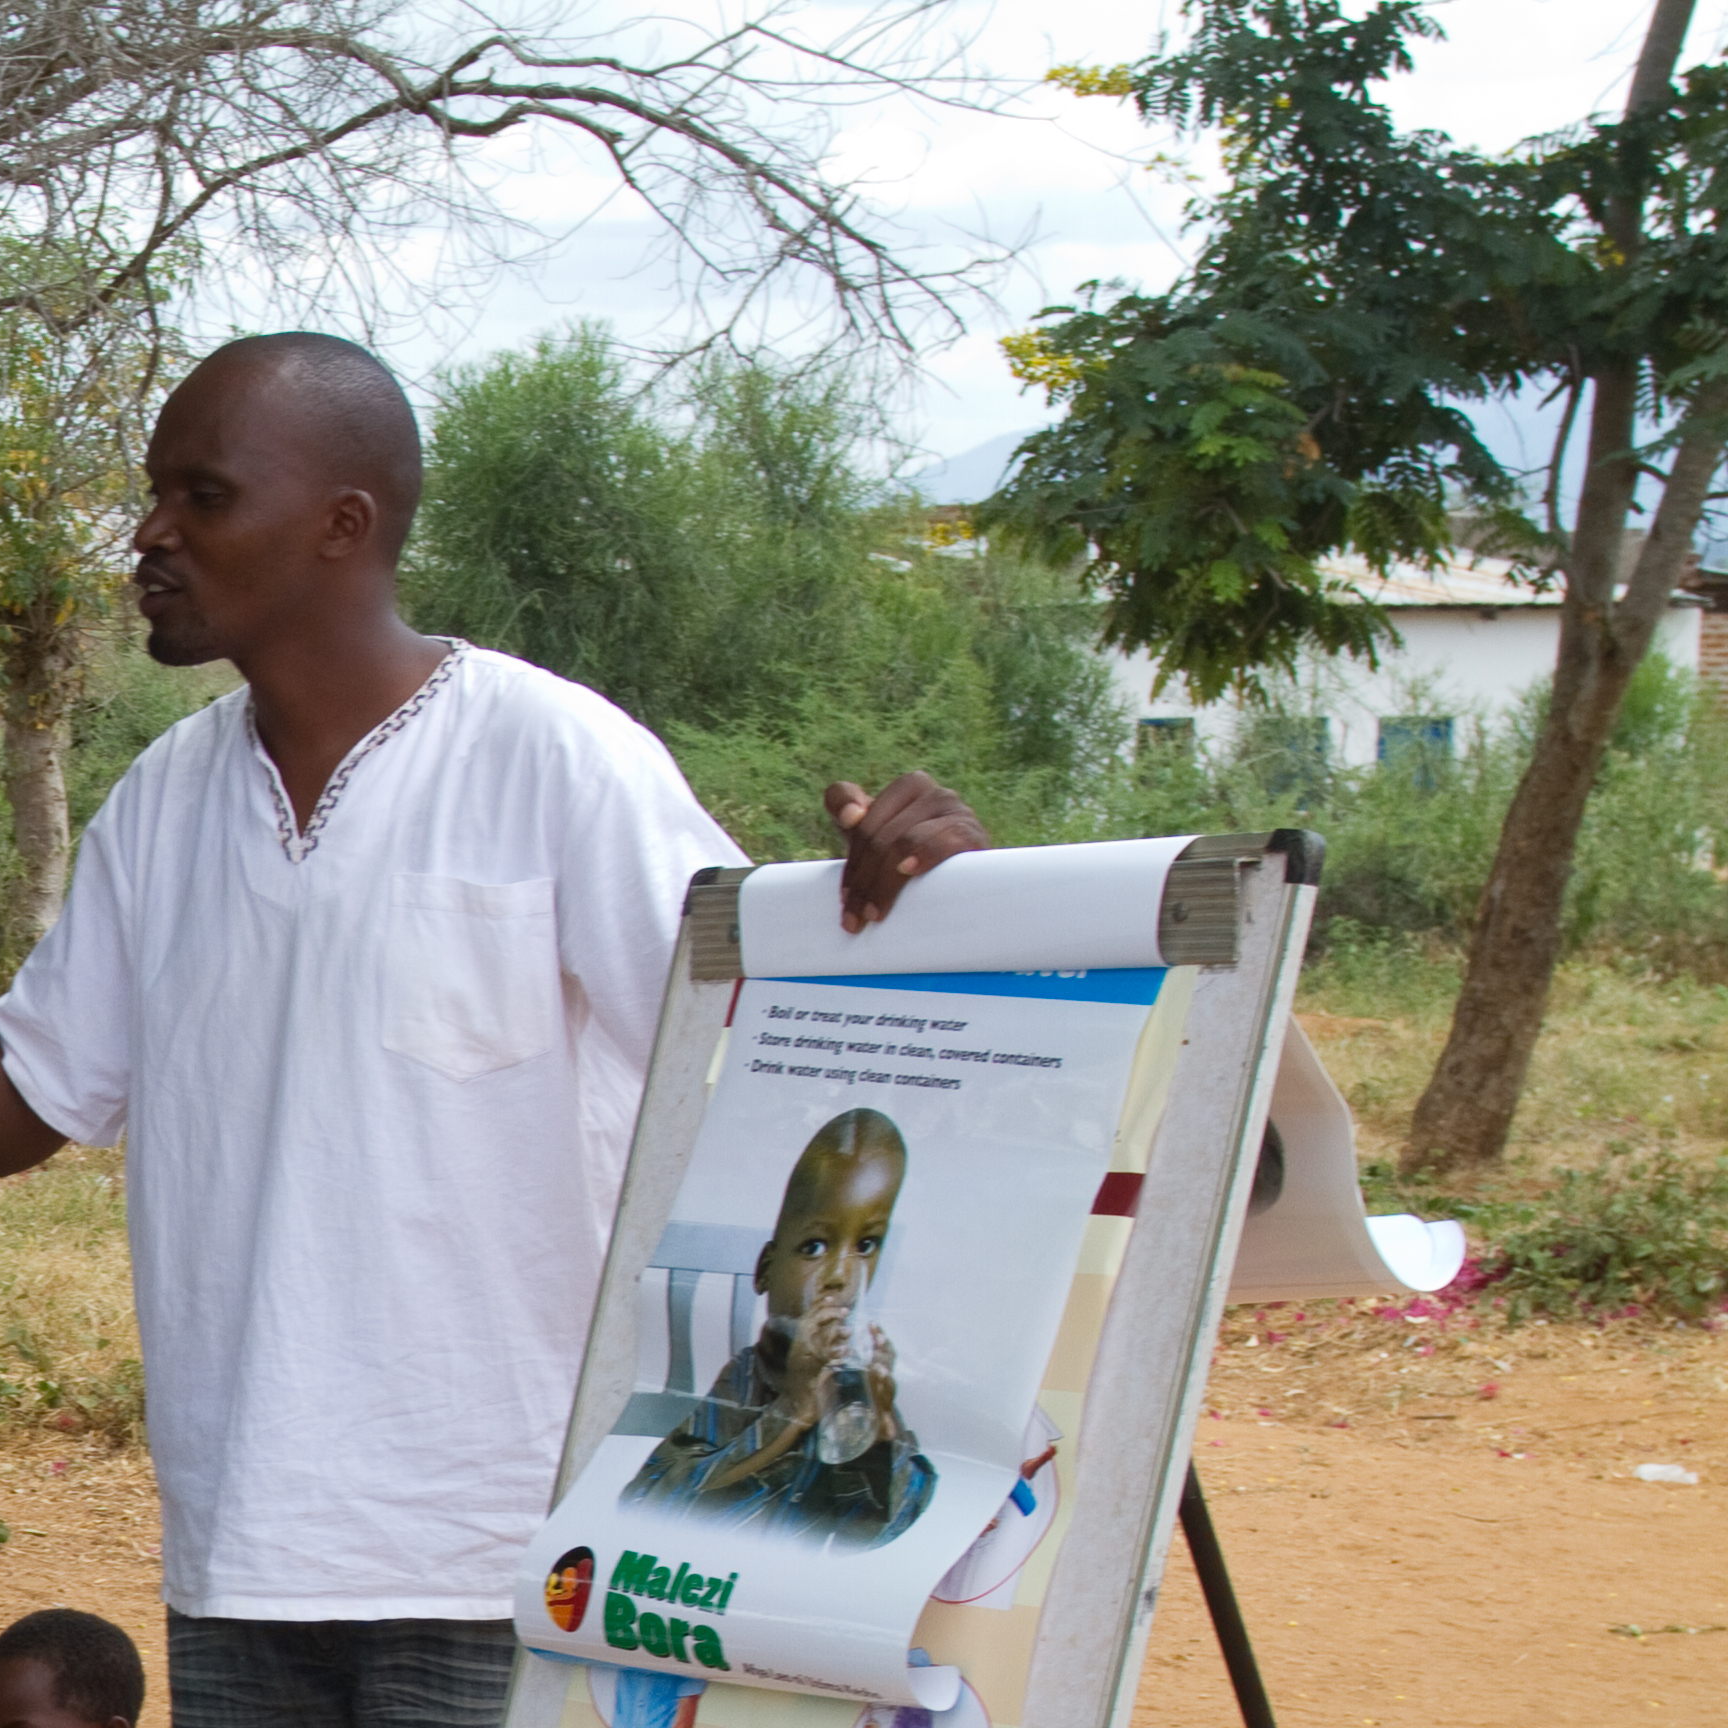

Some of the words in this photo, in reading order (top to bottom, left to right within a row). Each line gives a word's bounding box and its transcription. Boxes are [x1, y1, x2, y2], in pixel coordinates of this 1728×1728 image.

[767, 1005, 794, 1019] Boil
[794, 1010, 810, 1020] or
[810, 1009, 843, 1023] treat
[842, 1014, 875, 1027] your
[875, 1013, 928, 1033] drinking
[929, 1018, 968, 1031] water
[758, 1032, 792, 1047] Store
[793, 1035, 844, 1055] drinking
[846, 1041, 883, 1054] water
[882, 1041, 897, 1055] in
[899, 1043, 935, 1060] clean,
[938, 1048, 992, 1063] covered
[992, 1052, 1063, 1068] containers
[750, 1059, 785, 1074] Drink
[786, 1065, 823, 1078] water
[824, 1066, 858, 1085] using
[858, 1068, 893, 1084] clean
[894, 1073, 962, 1090] containers
[608, 1549, 739, 1615] Malezi
[604, 1591, 731, 1671] Bora
